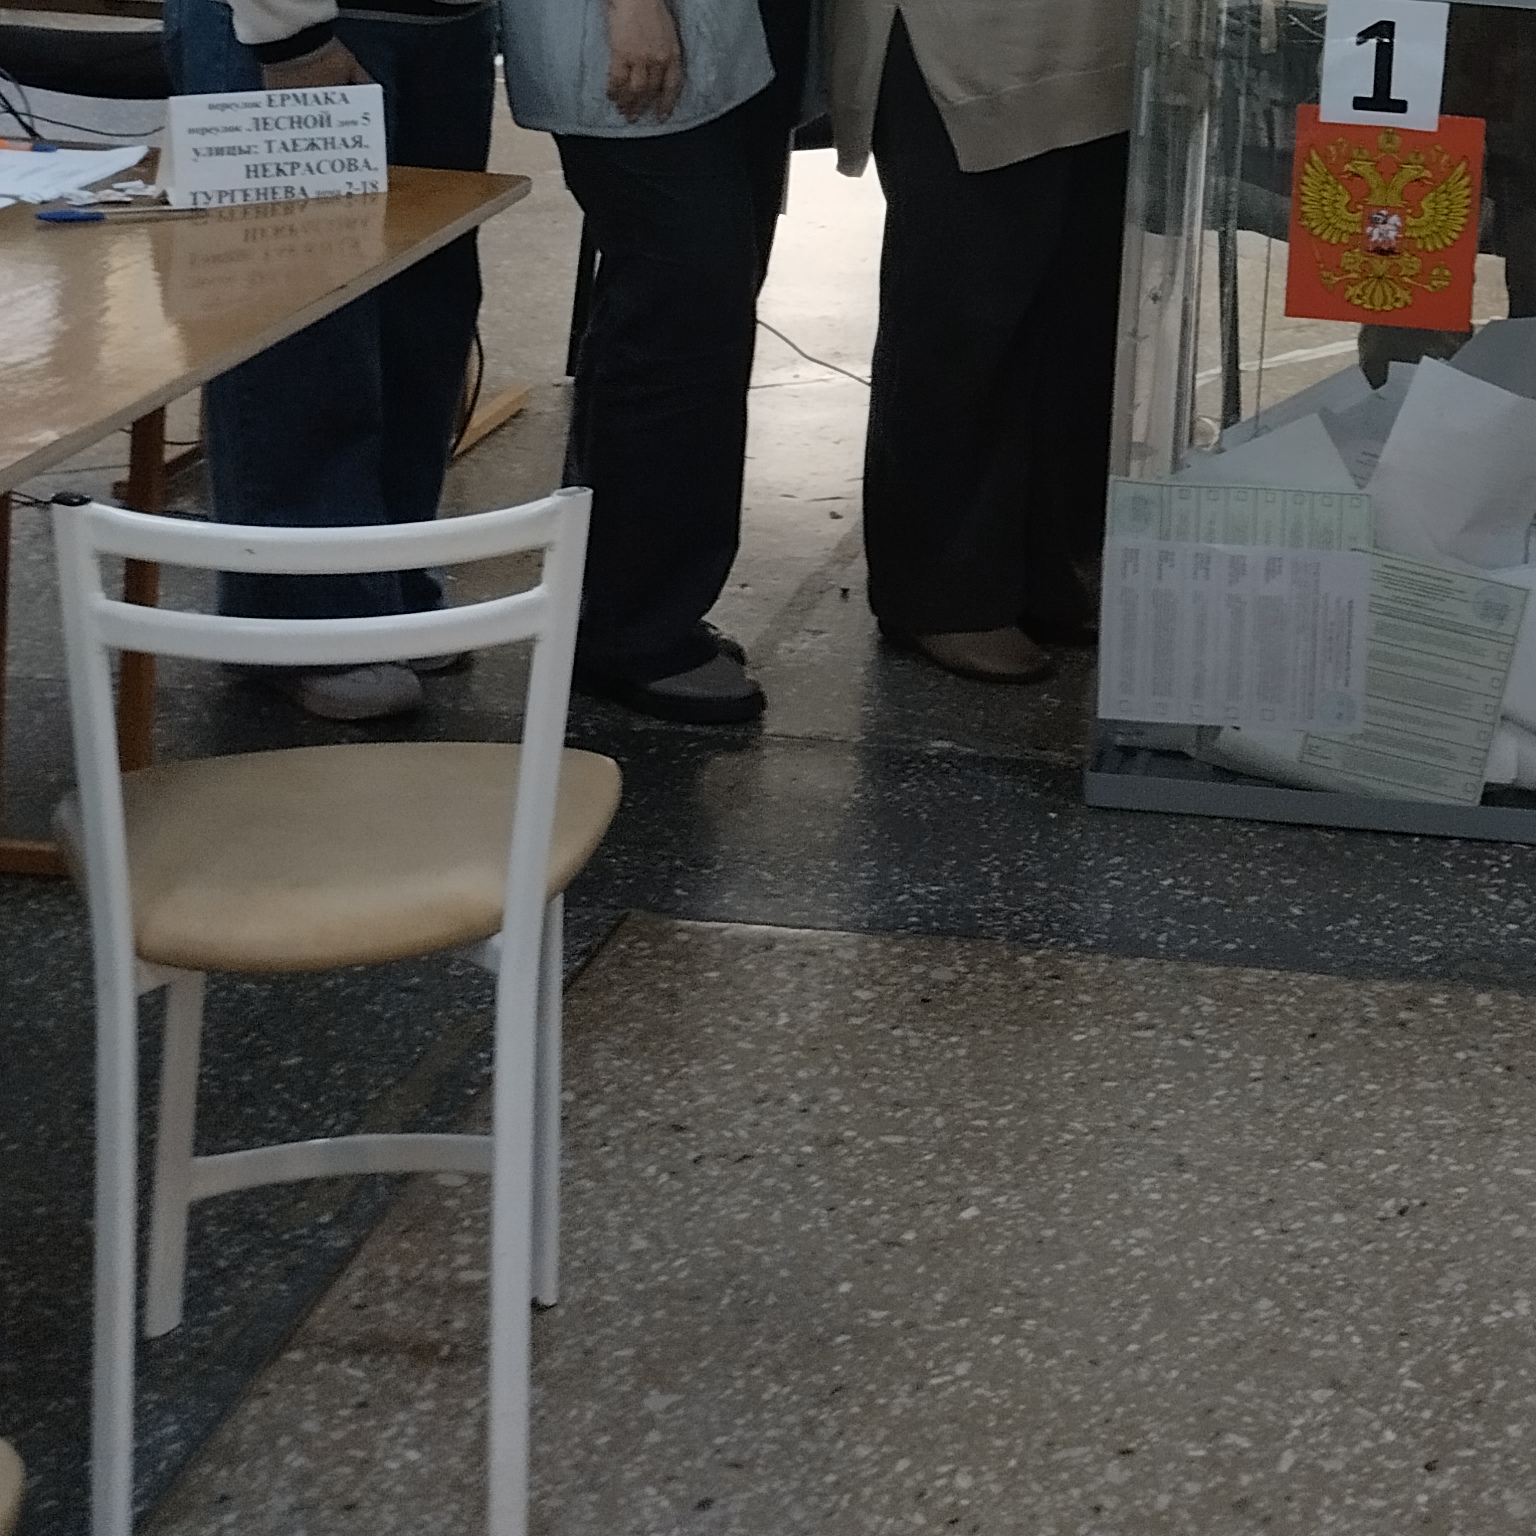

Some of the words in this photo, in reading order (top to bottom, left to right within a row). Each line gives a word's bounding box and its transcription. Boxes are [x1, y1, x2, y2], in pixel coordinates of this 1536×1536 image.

[1352, 20, 1408, 114] 1
[266, 91, 350, 108] ЕРМАКА
[245, 111, 332, 132] ЛЕСНОЙ
[361, 111, 371, 126] 5
[189, 185, 309, 206] ТУРГЕНЕВА
